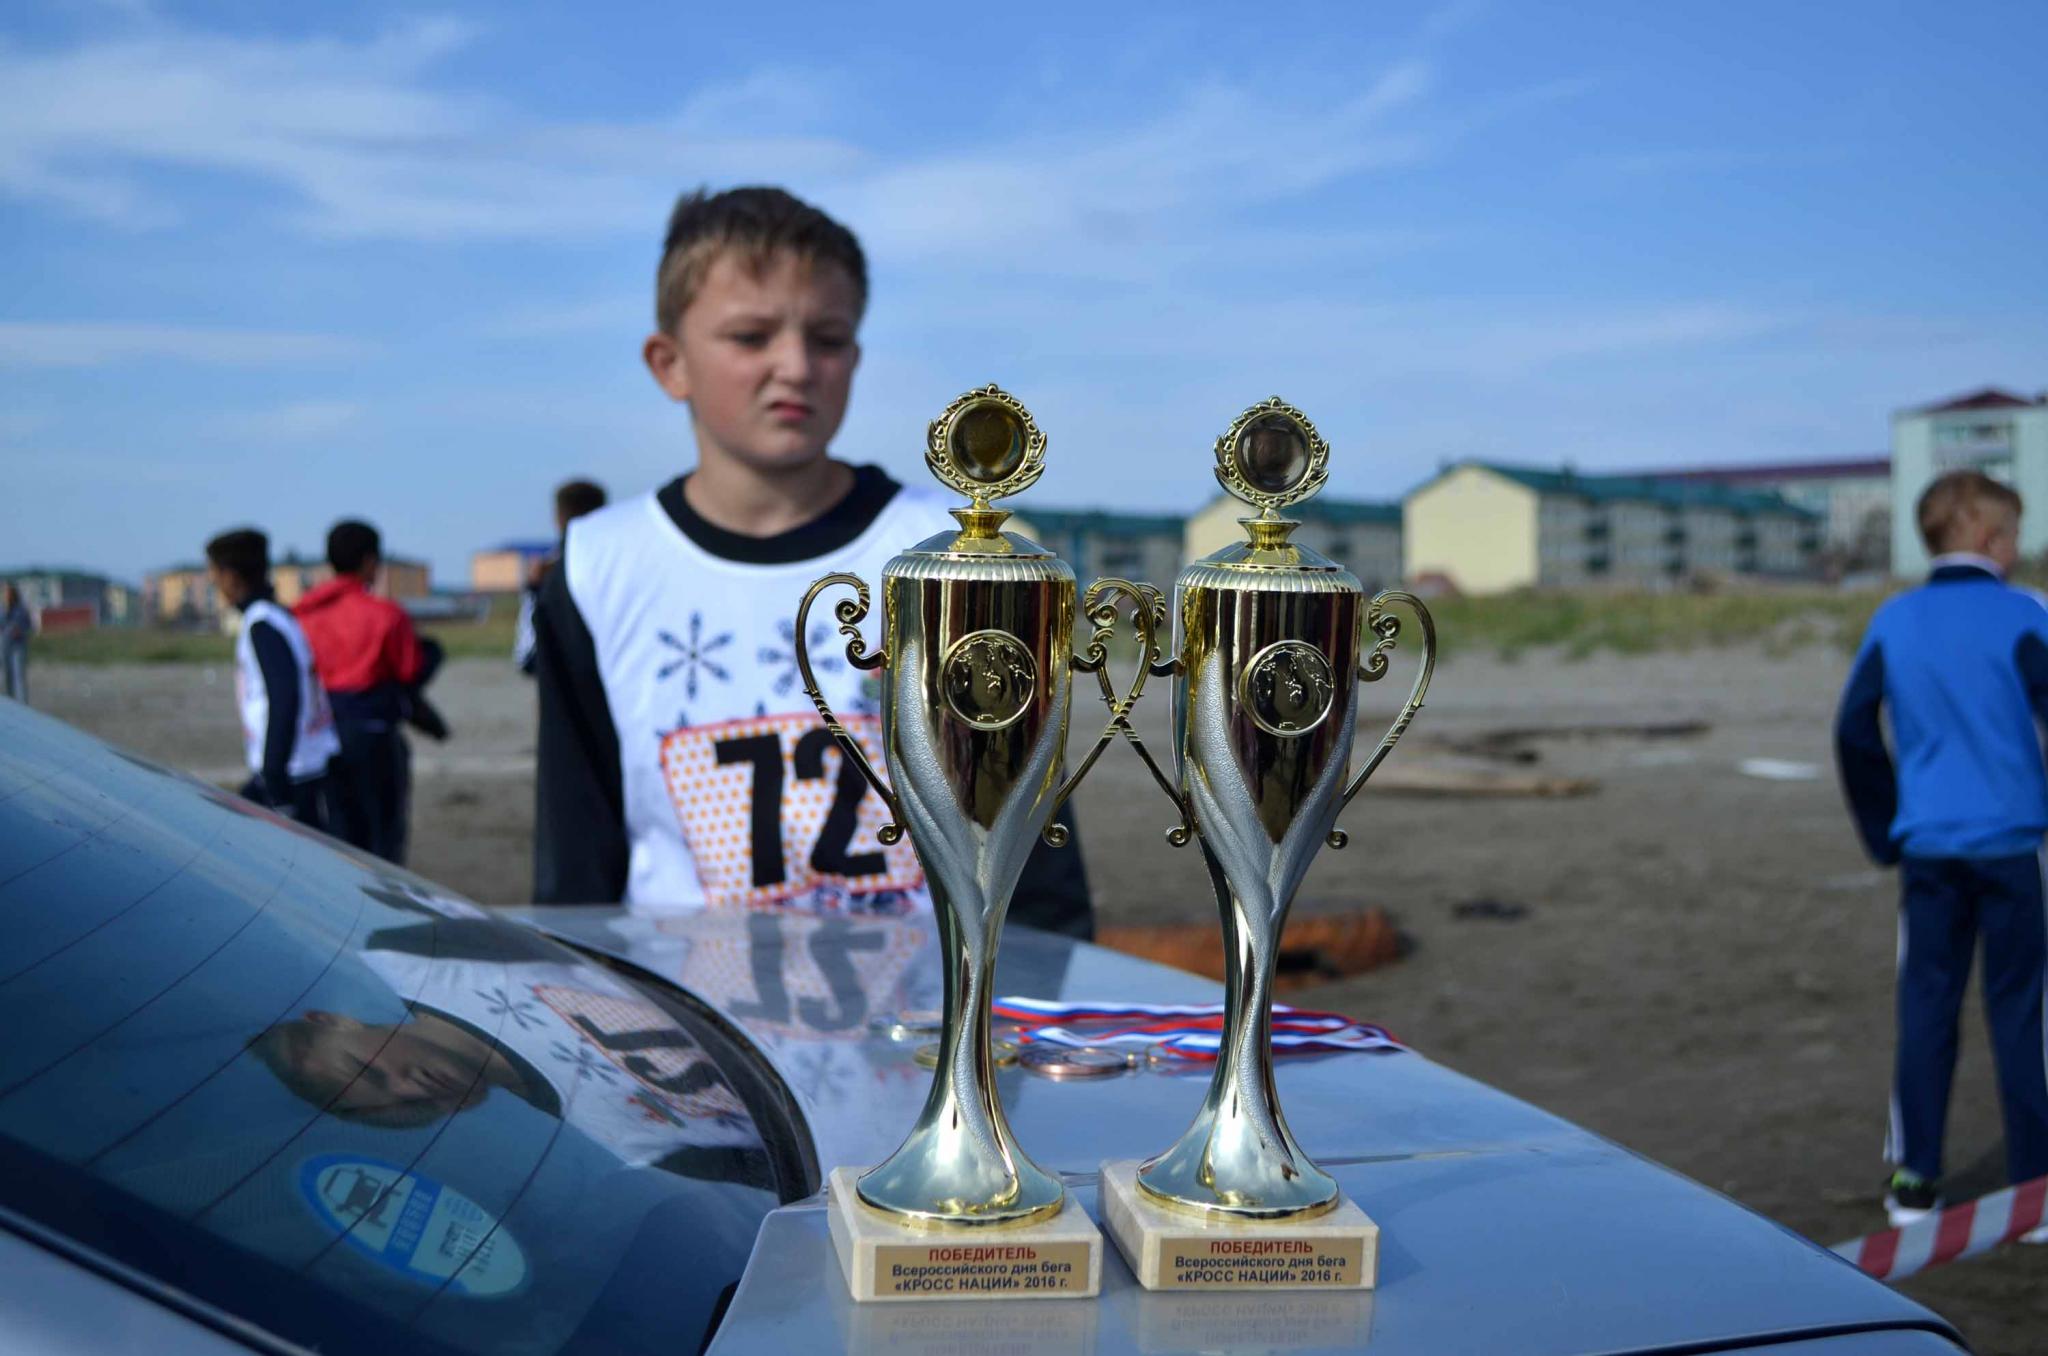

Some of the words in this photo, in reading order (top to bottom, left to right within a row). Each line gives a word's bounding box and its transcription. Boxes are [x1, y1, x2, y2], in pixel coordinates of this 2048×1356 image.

[714, 727, 888, 888] 72
[929, 1247, 1037, 1262] ПОБЕДИТЕЛЬ
[1210, 1241, 1313, 1255] ПОБЕДИТЕЛЬ
[892, 1263, 1008, 1278] Всероссийского
[1011, 1264, 1037, 1275] дня
[1041, 1261, 1072, 1273] бега
[1175, 1256, 1285, 1269] Всероссийского
[1288, 1258, 1313, 1269] дня
[1317, 1256, 1346, 1267] бега
[895, 1278, 954, 1292] «КРОСС
[959, 1276, 1020, 1291] НАЦИИ»
[1024, 1276, 1056, 1289] 2016
[1060, 1277, 1068, 1288] г.
[1177, 1270, 1234, 1283] «КРОСС
[1238, 1270, 1297, 1284] НАЦИИ»
[1301, 1269, 1331, 1282] 2016
[1334, 1272, 1342, 1282] г.
